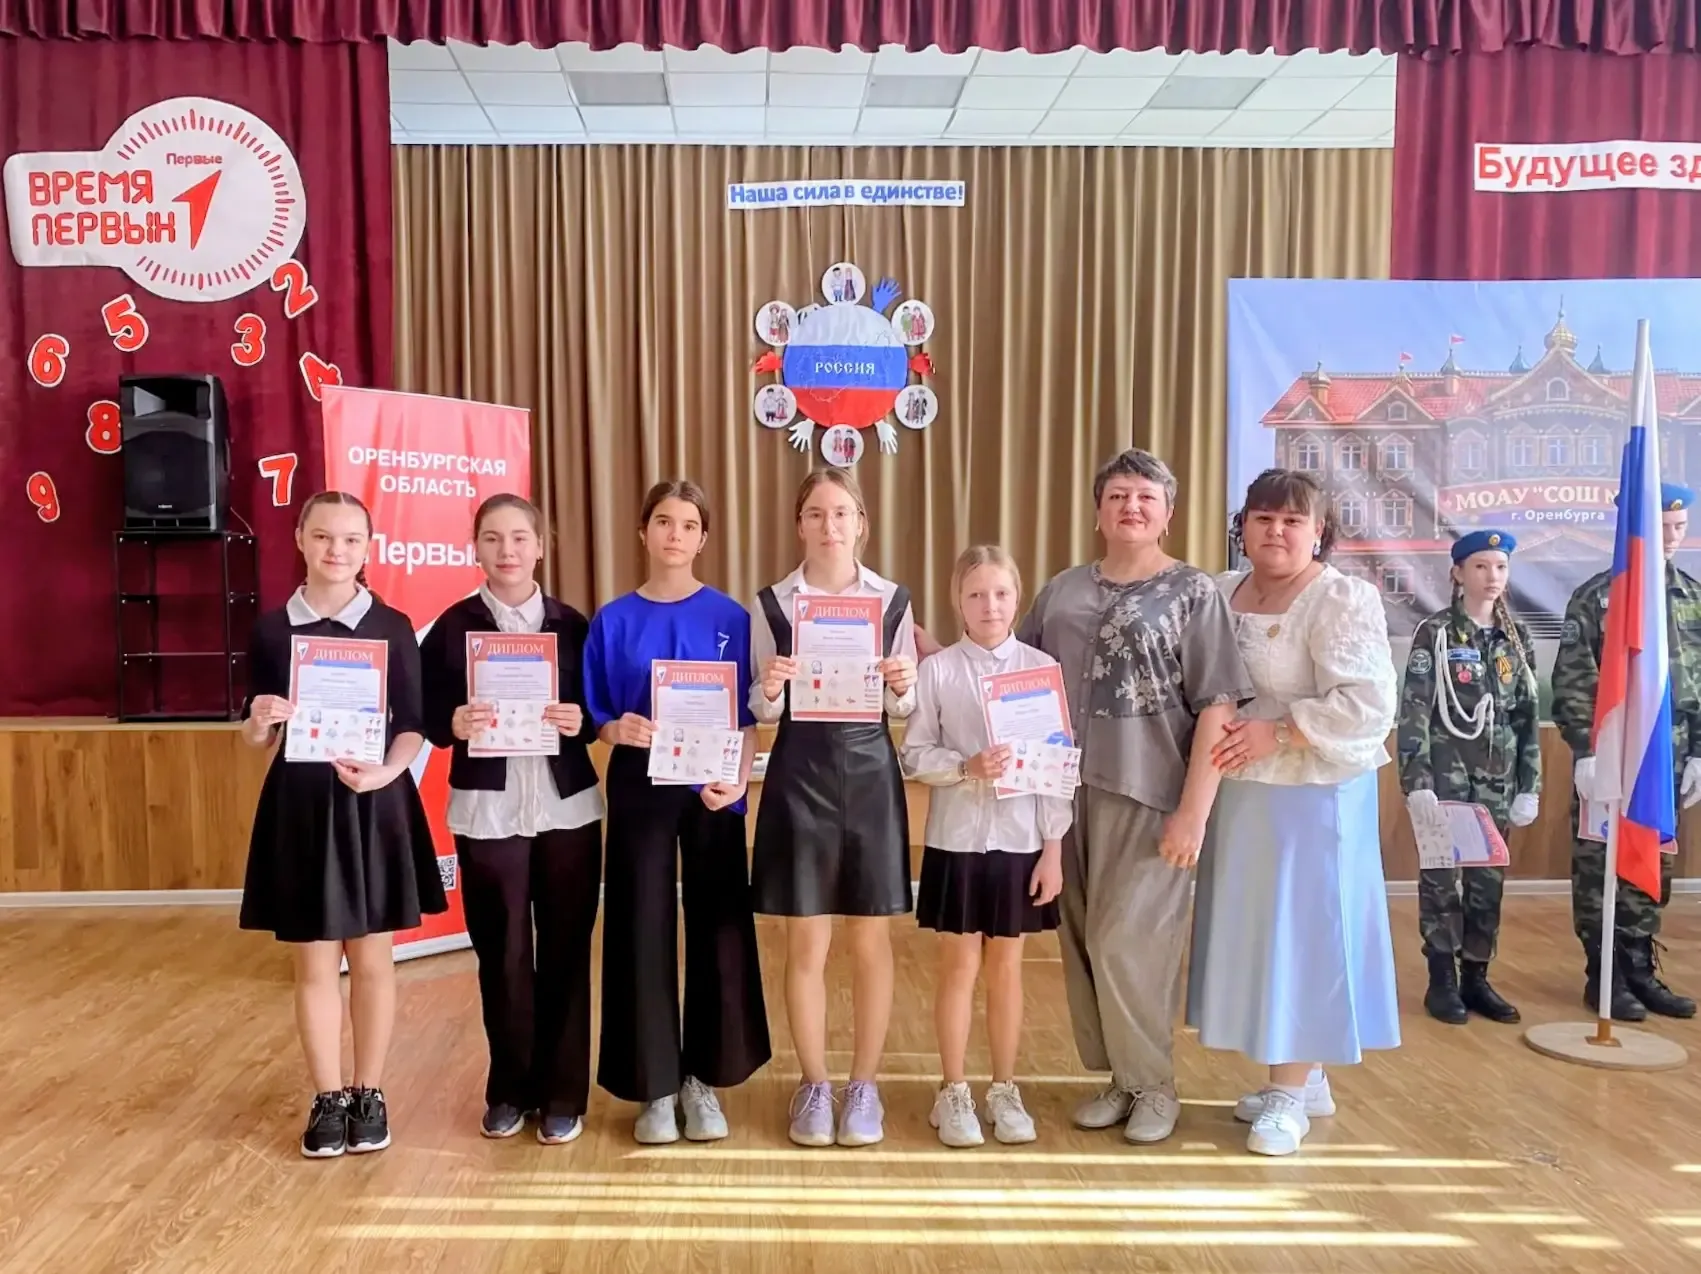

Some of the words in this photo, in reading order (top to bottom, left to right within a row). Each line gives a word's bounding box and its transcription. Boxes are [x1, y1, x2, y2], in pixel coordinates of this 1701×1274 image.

[166, 152, 223, 165] Первые
[1479, 146, 1659, 188] Будущее
[28, 169, 154, 206] ВРЕМЯ
[730, 185, 788, 203] Наша
[793, 185, 841, 200] сила
[844, 185, 855, 199] в
[860, 184, 963, 203] единстве!
[271, 260, 318, 318] 2
[102, 295, 149, 351] 5
[231, 313, 266, 366] 3
[27, 334, 69, 387] 6
[814, 361, 875, 375] РОССИЯ
[86, 400, 122, 454] 8
[347, 446, 507, 476] ОРЕНБУРГСКАЯ
[259, 453, 297, 506] 7
[379, 474, 477, 498] ОБЛАСТЬ
[26, 471, 60, 523] 9
[1455, 487, 1529, 512] МОАУ
[1511, 512, 1522, 521] г.
[1525, 509, 1605, 522] Оренбурга
[366, 533, 480, 575] Первы
[812, 606, 870, 618] ДИПЛОМ
[314, 648, 373, 661] ДИПЛОМ
[487, 643, 544, 656] ДИПЛОМ
